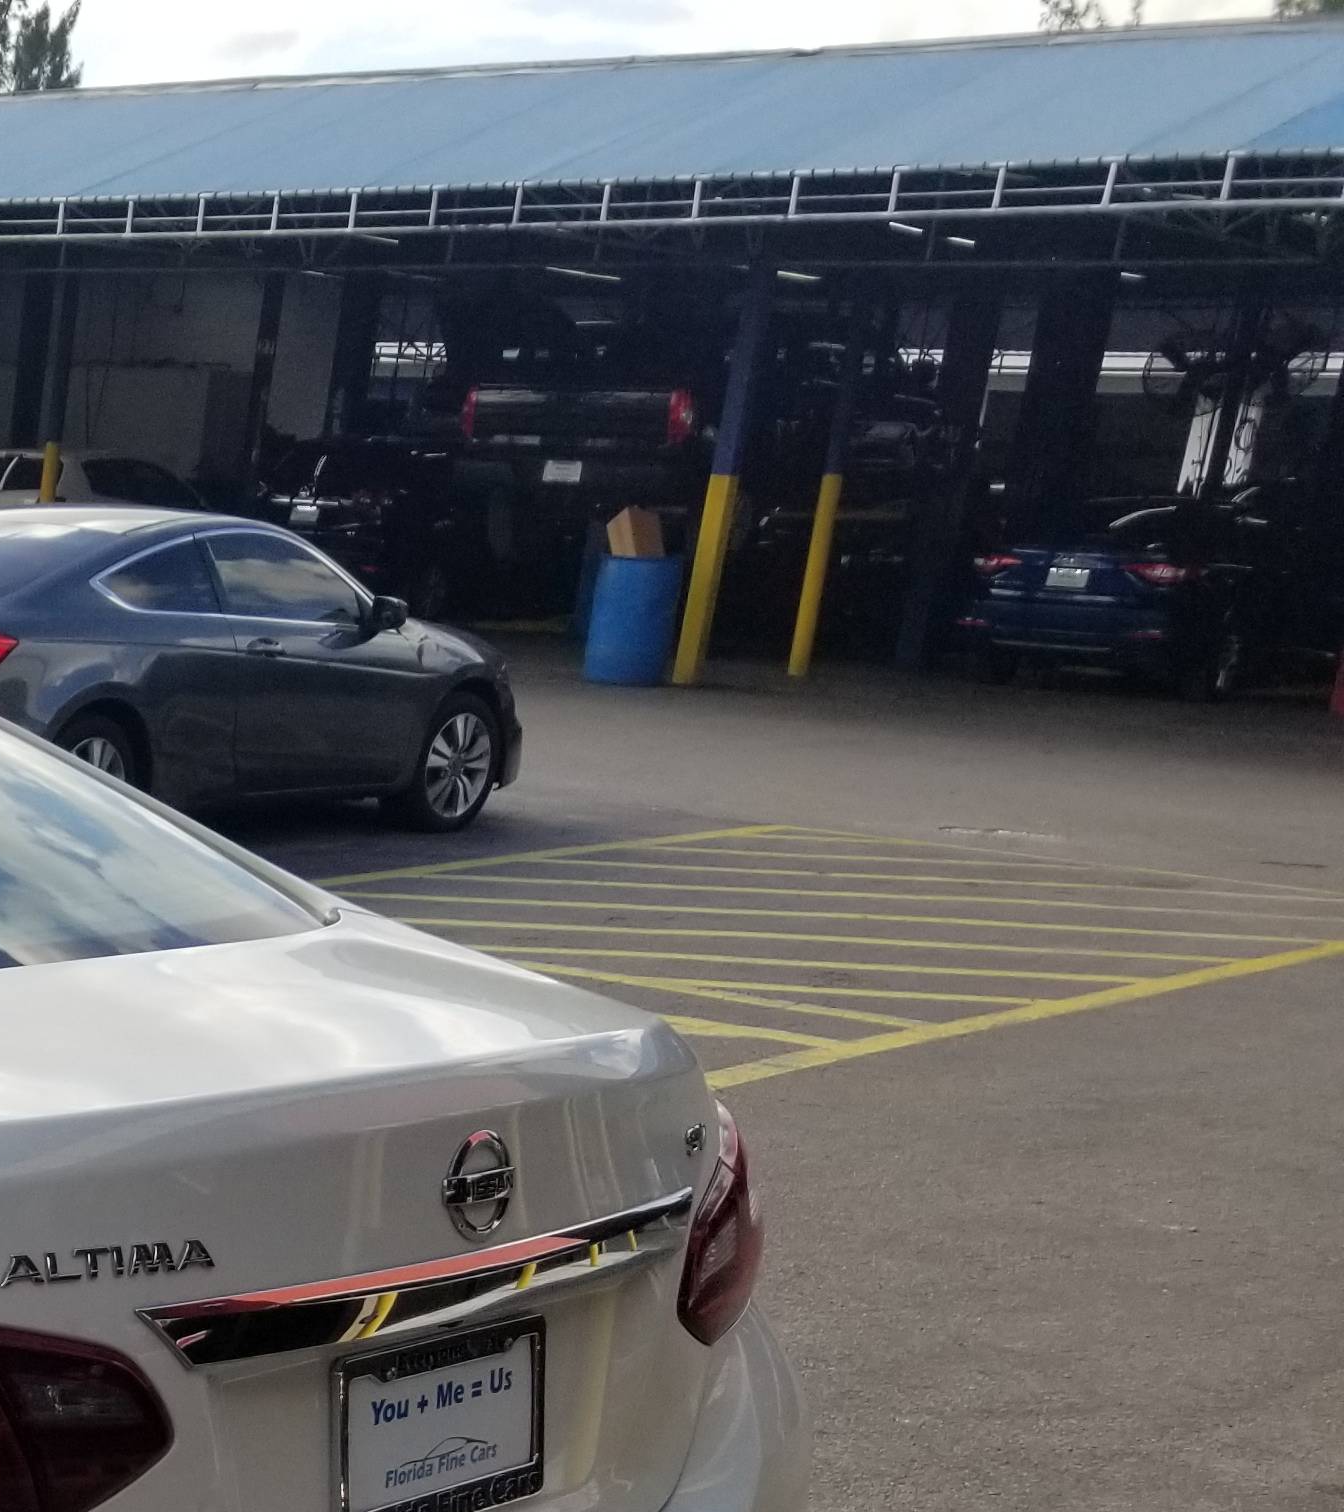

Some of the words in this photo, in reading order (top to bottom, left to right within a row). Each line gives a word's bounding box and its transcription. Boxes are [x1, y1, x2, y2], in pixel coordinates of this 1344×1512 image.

[0, 1239, 216, 1288] ALTIMA
[371, 1398, 409, 1426] You
[417, 1394, 429, 1414] +
[436, 1380, 465, 1409] Me
[471, 1380, 483, 1398] =
[489, 1367, 513, 1394] Us
[384, 1458, 434, 1489] Florida
[437, 1453, 466, 1474] Fine
[470, 1443, 498, 1464] Cars
[489, 1471, 539, 1505] Cars
